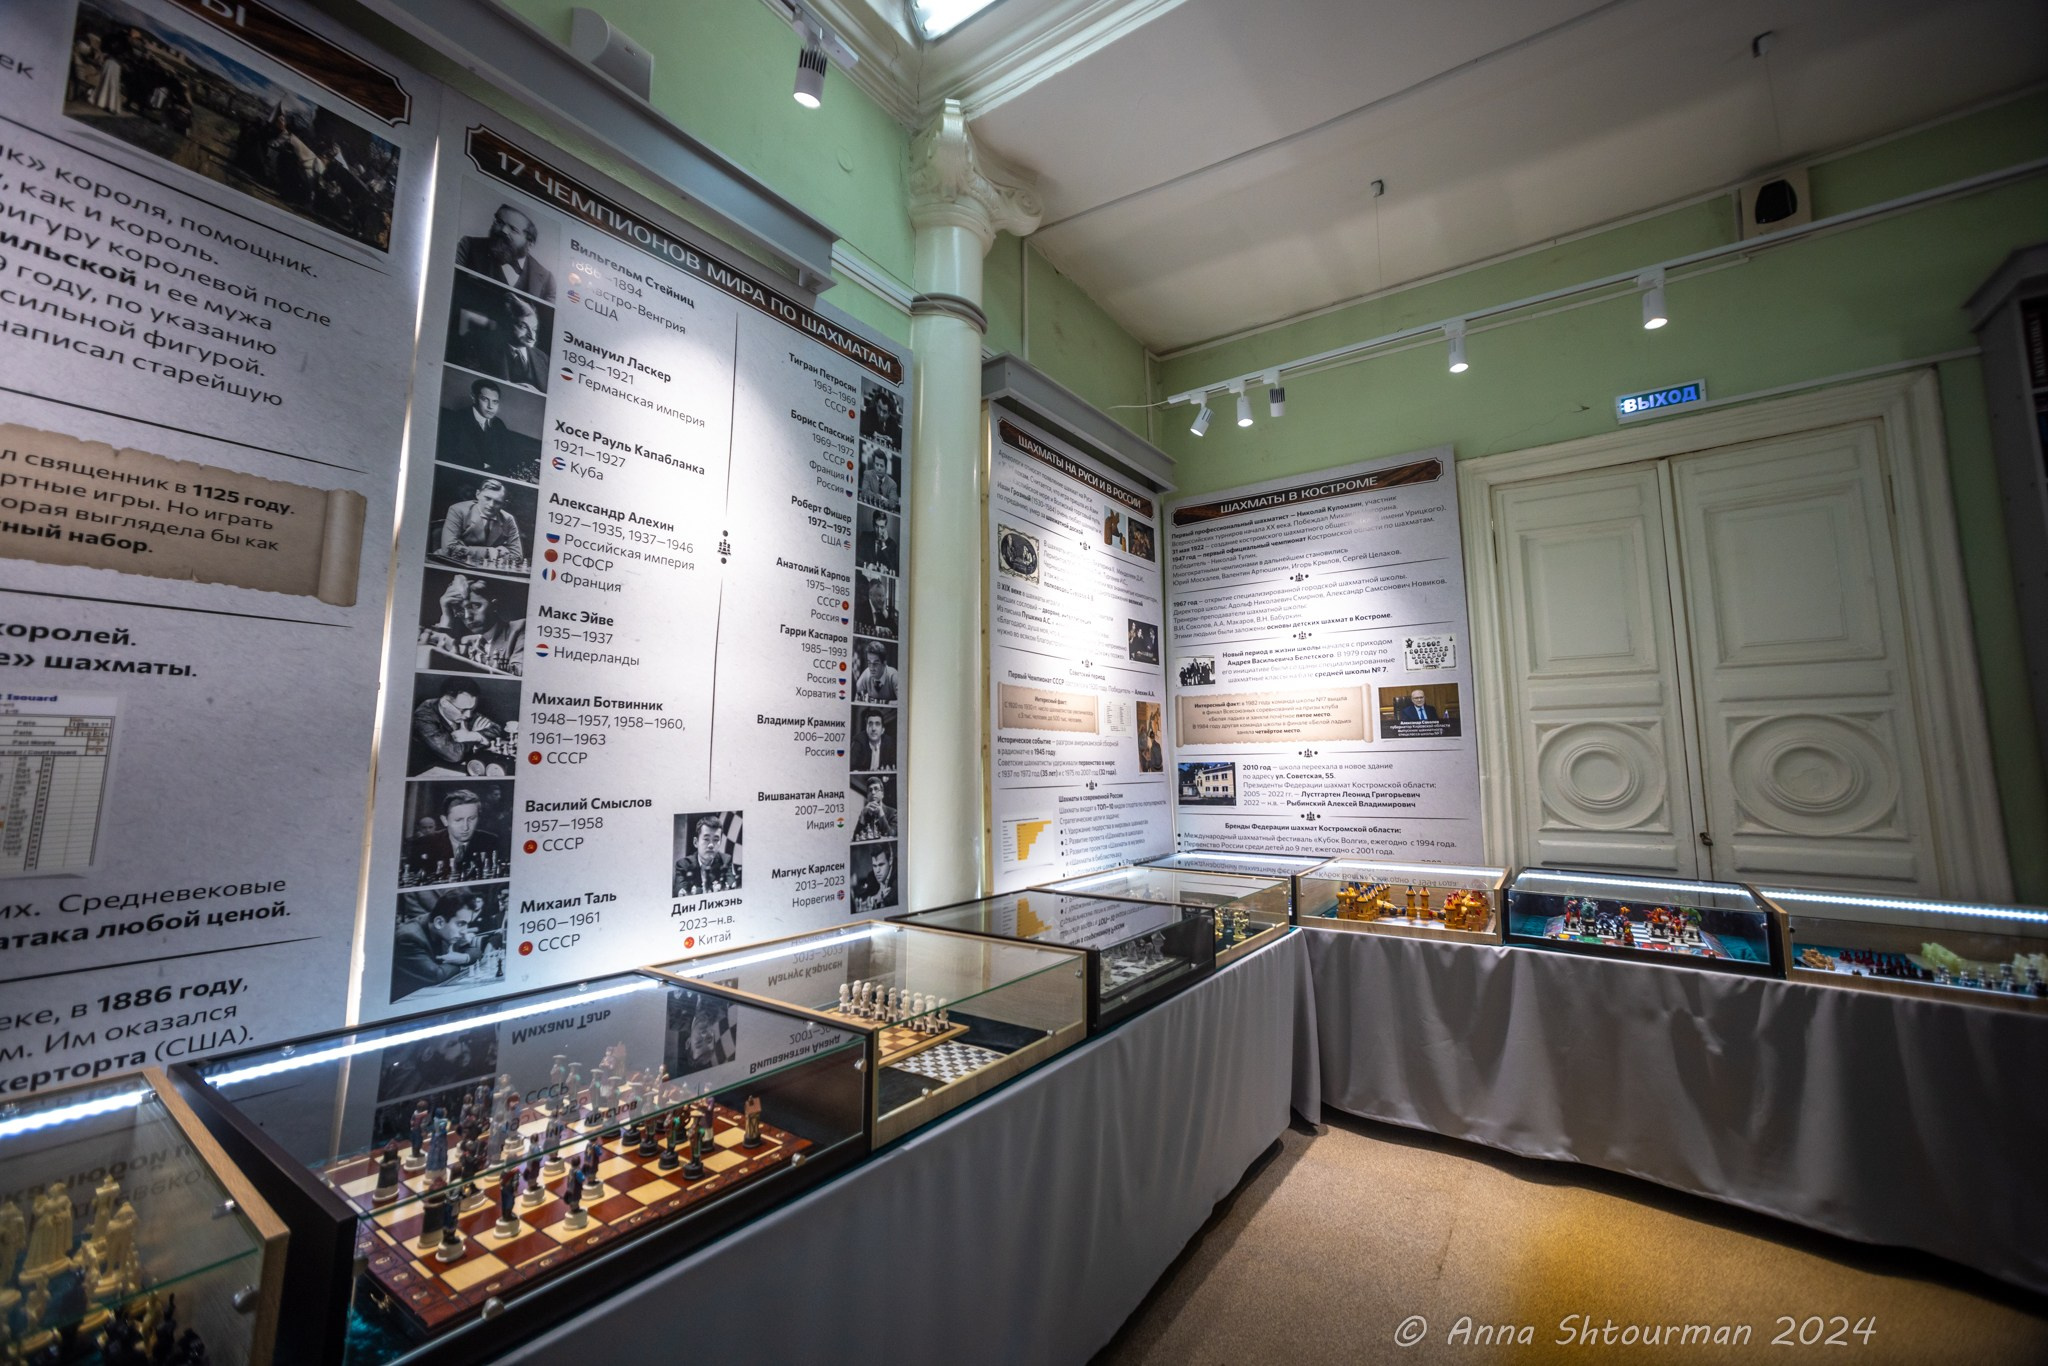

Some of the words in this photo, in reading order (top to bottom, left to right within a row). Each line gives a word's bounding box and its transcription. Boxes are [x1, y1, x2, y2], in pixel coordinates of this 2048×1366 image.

[20, 182, 75, 213] как
[111, 213, 219, 266] король.
[55, 167, 173, 226] короля,
[181, 215, 318, 278] помощник.
[498, 151, 525, 178] 17
[534, 169, 700, 271] ЧЕМПИОНОВ
[707, 262, 767, 307] МИРА
[770, 290, 796, 321] ПО
[801, 314, 891, 374] ШАХМАТАМ
[108, 240, 258, 303] королевой
[264, 294, 331, 327] после
[570, 239, 643, 282] Вильгельм
[645, 276, 695, 310] Стейниц
[17, 265, 97, 303] году,
[106, 292, 142, 314] по
[151, 306, 277, 356] указанию
[168, 287, 198, 307] ее
[205, 300, 273, 331] мужа
[584, 298, 618, 321] США
[0, 288, 136, 340] сильной
[144, 328, 266, 377] фигурой.
[563, 331, 625, 364] Эмануил
[627, 356, 671, 383] Ласкер
[133, 357, 283, 407] старейшую
[789, 352, 819, 375] Тигран
[819, 368, 857, 394] Петросян
[578, 373, 653, 409] Германская
[656, 403, 705, 428] империя
[1623, 386, 1697, 413] ВЫХОД
[790, 409, 817, 428] Борис
[818, 422, 855, 445] Спасский
[555, 420, 590, 440] Хосе
[592, 431, 632, 452] Рауль
[634, 444, 705, 476] Капабланка
[570, 462, 604, 480] Куба
[1018, 435, 1064, 467] ШАХМАТЫ
[1065, 460, 1077, 475] НА
[1078, 468, 1099, 487] РУСИ
[1100, 479, 1106, 490] И
[1106, 484, 1112, 494] В
[1113, 487, 1141, 509] РОССИИ
[24, 452, 169, 491] священник
[192, 484, 240, 503] 1125
[244, 494, 295, 515] году.
[1220, 493, 1285, 514] ШАХМАТЫ
[1289, 492, 1297, 500] В
[1301, 476, 1378, 499] КОСТРОМЕ
[94, 490, 160, 512] игры.
[169, 500, 199, 518] Но
[204, 508, 274, 531] играть
[549, 493, 625, 521] Александр
[628, 512, 674, 532] Алехин
[791, 495, 822, 513] Роберт
[823, 506, 852, 524] Фишер
[76, 508, 206, 540] выглядела
[211, 528, 240, 545] бы
[246, 535, 279, 551] как
[1395, 517, 1435, 528] шахматам.
[69, 530, 153, 554] набор.
[564, 534, 641, 560] Российская
[644, 554, 695, 570] империя
[821, 534, 842, 547] США
[562, 553, 614, 571] РСФСР
[1342, 553, 1368, 562] Сергей
[776, 557, 819, 574] Анатолий
[820, 567, 851, 583] Карпов
[561, 572, 622, 593] Франция
[538, 605, 577, 622] Макс
[580, 611, 614, 627] Эйве
[1267, 622, 1291, 630] основы
[1293, 620, 1319, 628] детских
[1354, 612, 1392, 621] Костроме.
[780, 624, 806, 637] Гарри
[808, 629, 848, 643] Каспаров
[44, 655, 197, 678] шахматы.
[554, 646, 640, 666] Нидерланды
[1315, 669, 1343, 677] средней
[532, 692, 590, 707] Михаил
[593, 696, 663, 711] Ботвинник
[795, 687, 836, 701] Хорватия
[757, 714, 806, 729] Владимир
[807, 716, 845, 728] Крамник
[547, 752, 588, 764] СССР
[805, 747, 835, 757] Россия
[525, 798, 588, 813] Василий
[591, 797, 652, 810] Смыслов
[758, 791, 816, 801] Вишванатан
[817, 789, 845, 800] Ананд
[1301, 791, 1341, 799] Лустгартен
[1342, 791, 1370, 799] Леонид
[1371, 791, 1420, 799] Григорьевич
[1359, 801, 1415, 809] Владимирович
[806, 820, 835, 830] Индия
[1225, 823, 1250, 831] Бренды
[1251, 824, 1289, 832] Федерации
[1319, 826, 1367, 834] Костромской
[542, 837, 584, 852] СССР
[771, 868, 807, 880] Магнус
[808, 862, 845, 876] Карлсен
[59, 879, 286, 916] Средневековые
[520, 895, 580, 914] Михаил
[585, 891, 616, 904] Таль
[671, 903, 696, 917] Дин
[699, 897, 742, 911] Лижэнь
[792, 892, 835, 908] Норвегия
[96, 911, 200, 939] любой
[205, 901, 291, 926] ценой.
[538, 933, 580, 952] СССР
[698, 931, 732, 946] Китай
[97, 985, 172, 1013] 1886
[180, 977, 248, 1000] году,
[45, 1032, 95, 1056] Им
[105, 1005, 237, 1042] оказался
[154, 1025, 254, 1061] (США).
